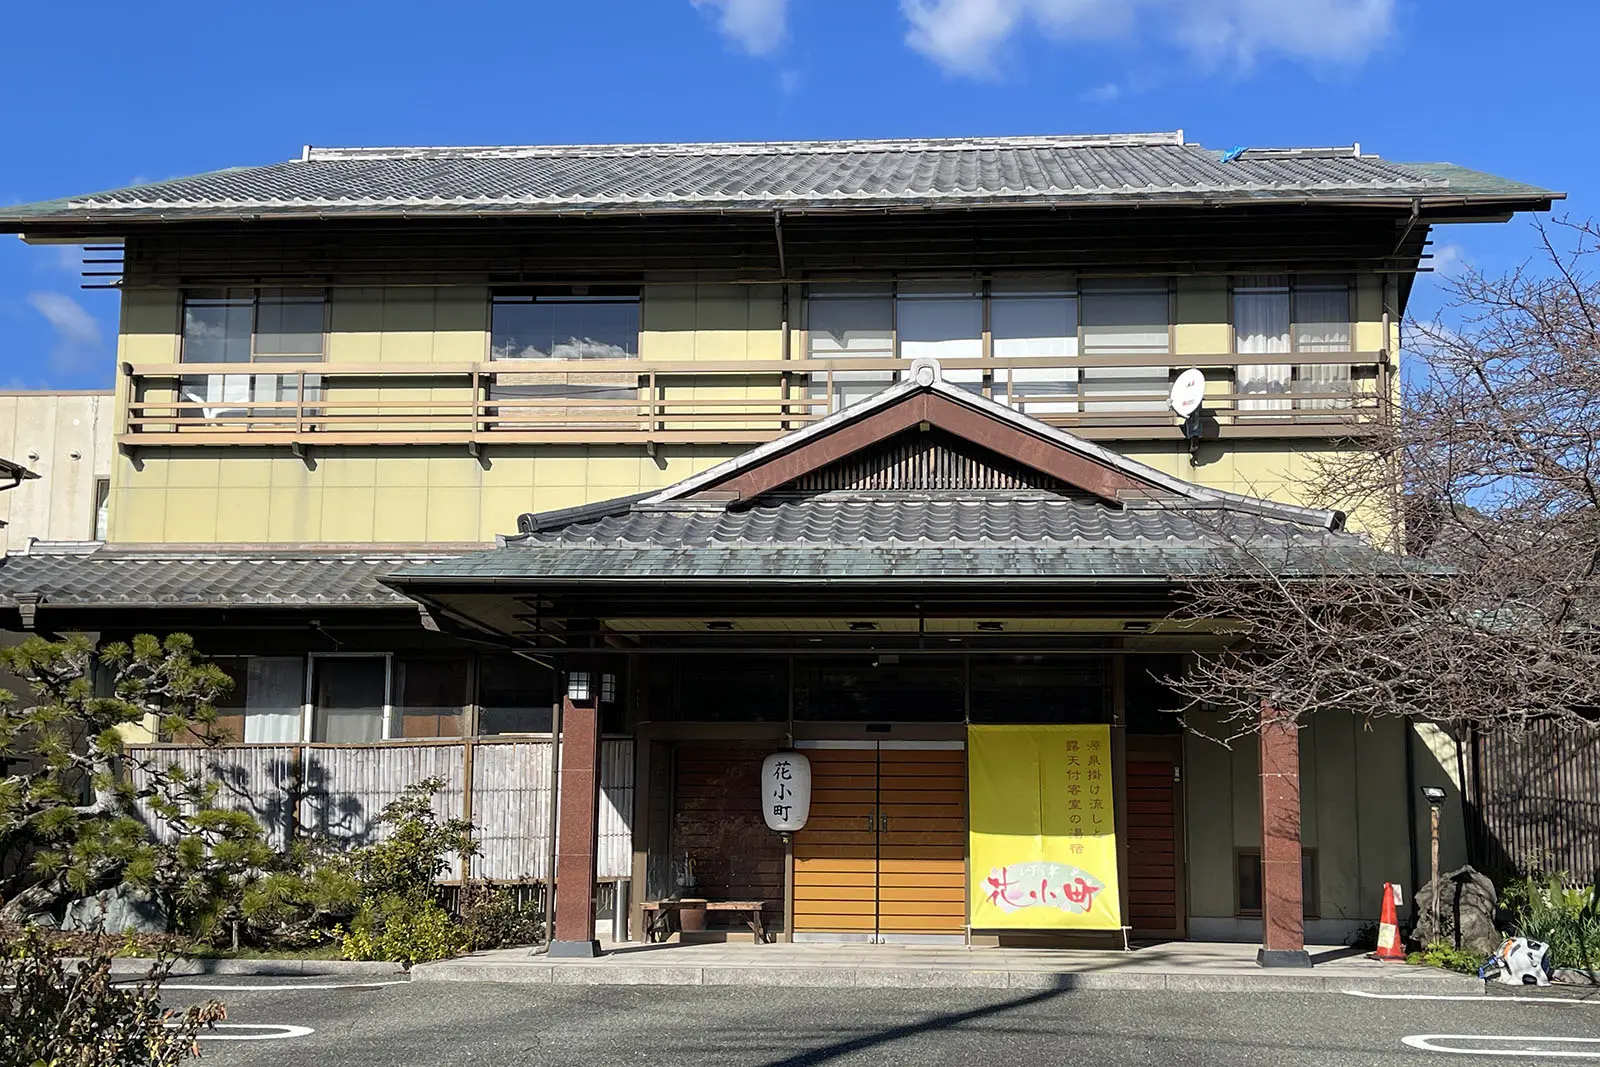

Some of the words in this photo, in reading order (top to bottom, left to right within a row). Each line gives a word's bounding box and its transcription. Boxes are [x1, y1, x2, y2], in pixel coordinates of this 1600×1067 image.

[773, 760, 792, 822] 花小町
[1066, 740, 1084, 854] 露天付客室の湯宿
[1087, 740, 1104, 839] 源泉掛け流しと
[986, 867, 1100, 912] 花小町
